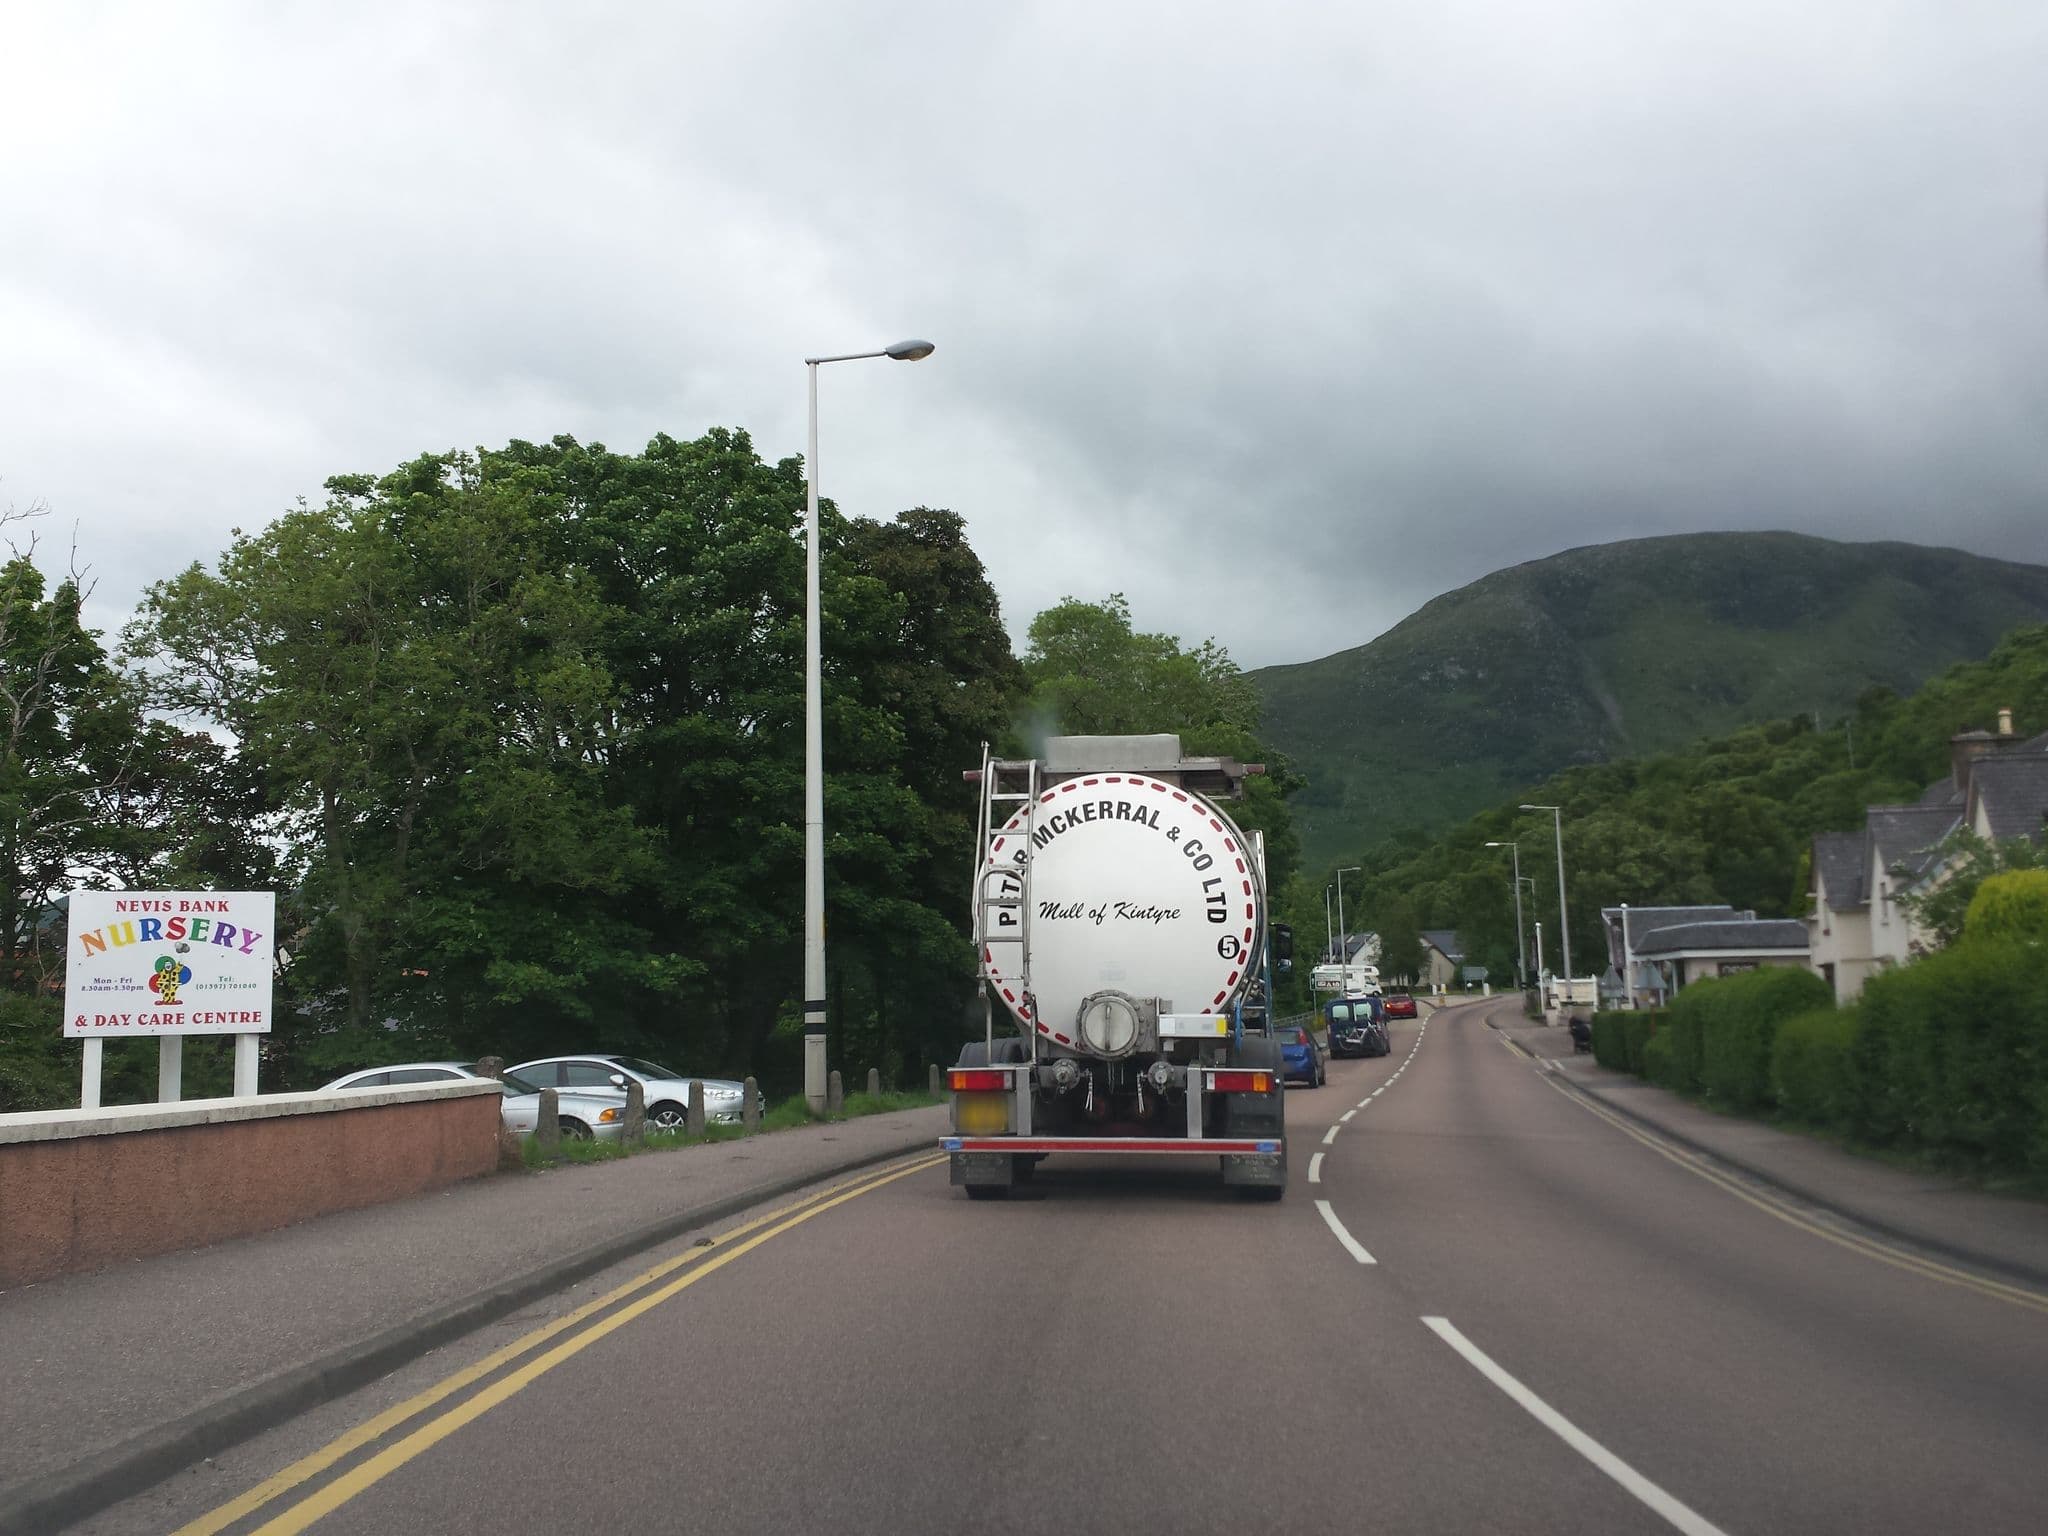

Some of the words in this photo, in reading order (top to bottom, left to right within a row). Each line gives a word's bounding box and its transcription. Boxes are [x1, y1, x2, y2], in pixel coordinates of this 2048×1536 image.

[1031, 801, 1161, 850] MCKERRAL
[1166, 826, 1181, 842] &
[1183, 839, 1213, 871] CO
[1202, 877, 1227, 924] LTD
[116, 900, 172, 913] NEVIS
[179, 900, 230, 913] BANK
[1039, 902, 1083, 920] Mull
[1088, 903, 1108, 925] of
[1113, 902, 1182, 925] Kintyre
[79, 916, 263, 957] NURSERY
[75, 1014, 88, 1027] &
[95, 1013, 132, 1026] DAY
[138, 1012, 185, 1025] CARE
[192, 1010, 262, 1024] CENTRE
